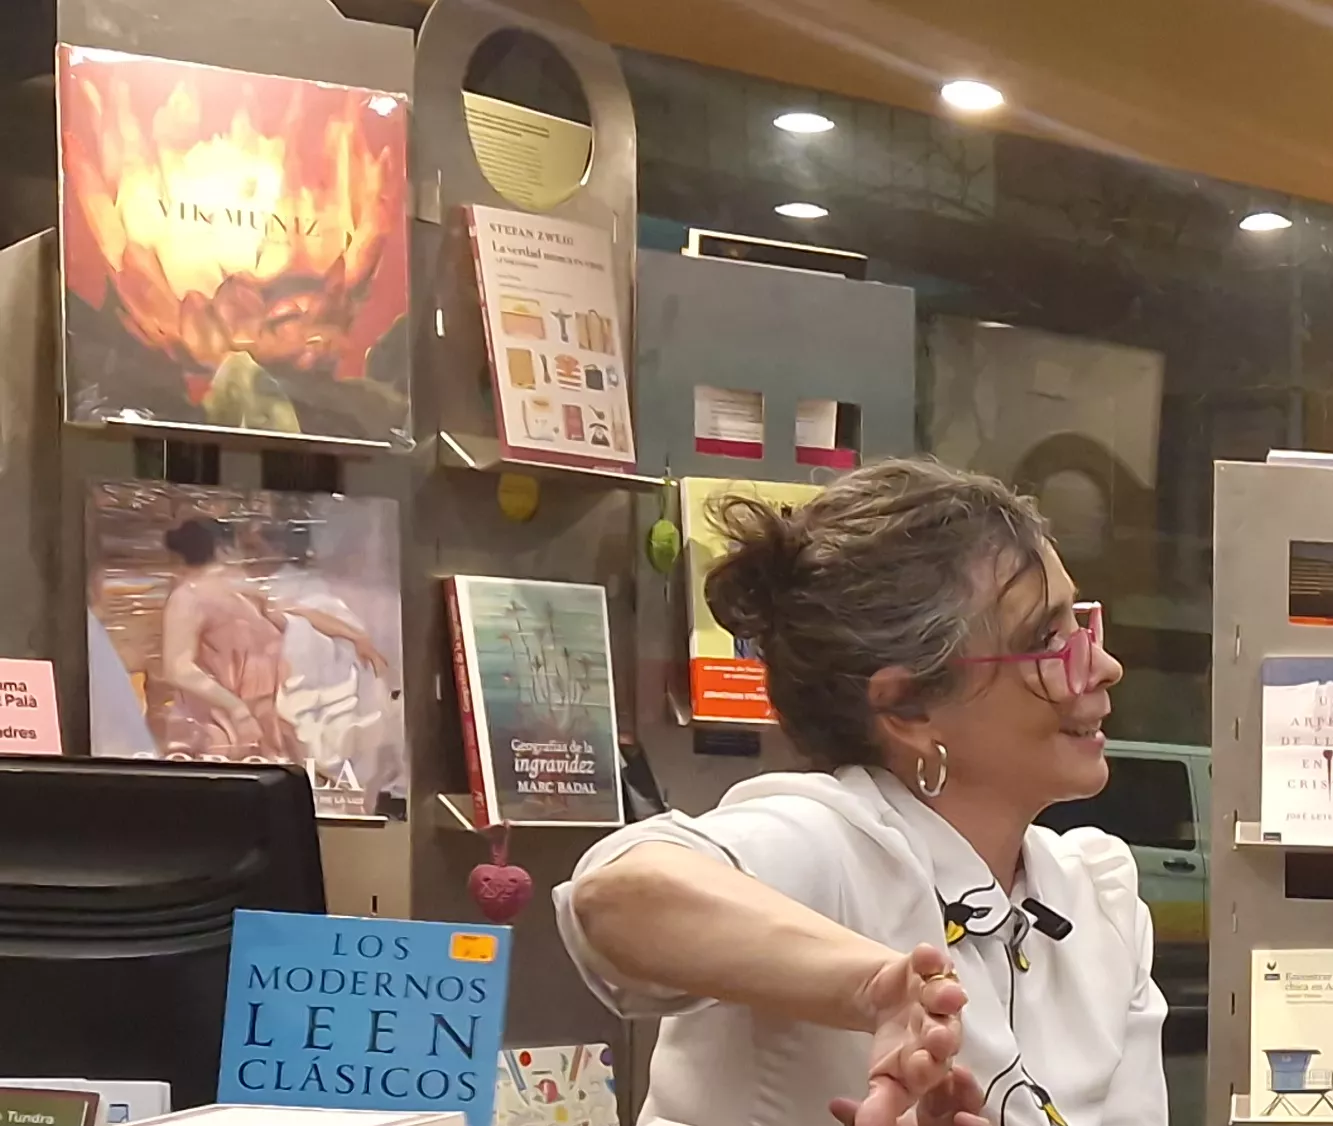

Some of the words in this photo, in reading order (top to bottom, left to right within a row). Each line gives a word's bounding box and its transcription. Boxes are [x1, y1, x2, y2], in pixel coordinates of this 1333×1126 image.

[569, 741, 584, 754] de
[584, 742, 594, 755] la
[513, 754, 596, 781] ingravidez
[1302, 758, 1323, 770] EN
[517, 780, 555, 794] MARC
[332, 933, 411, 961] LOS
[247, 964, 487, 1004] MODERNOS
[243, 1001, 482, 1061] LEEN
[237, 1055, 479, 1102] CLÁSICOS
[7, 1109, 56, 1126] Tundra
